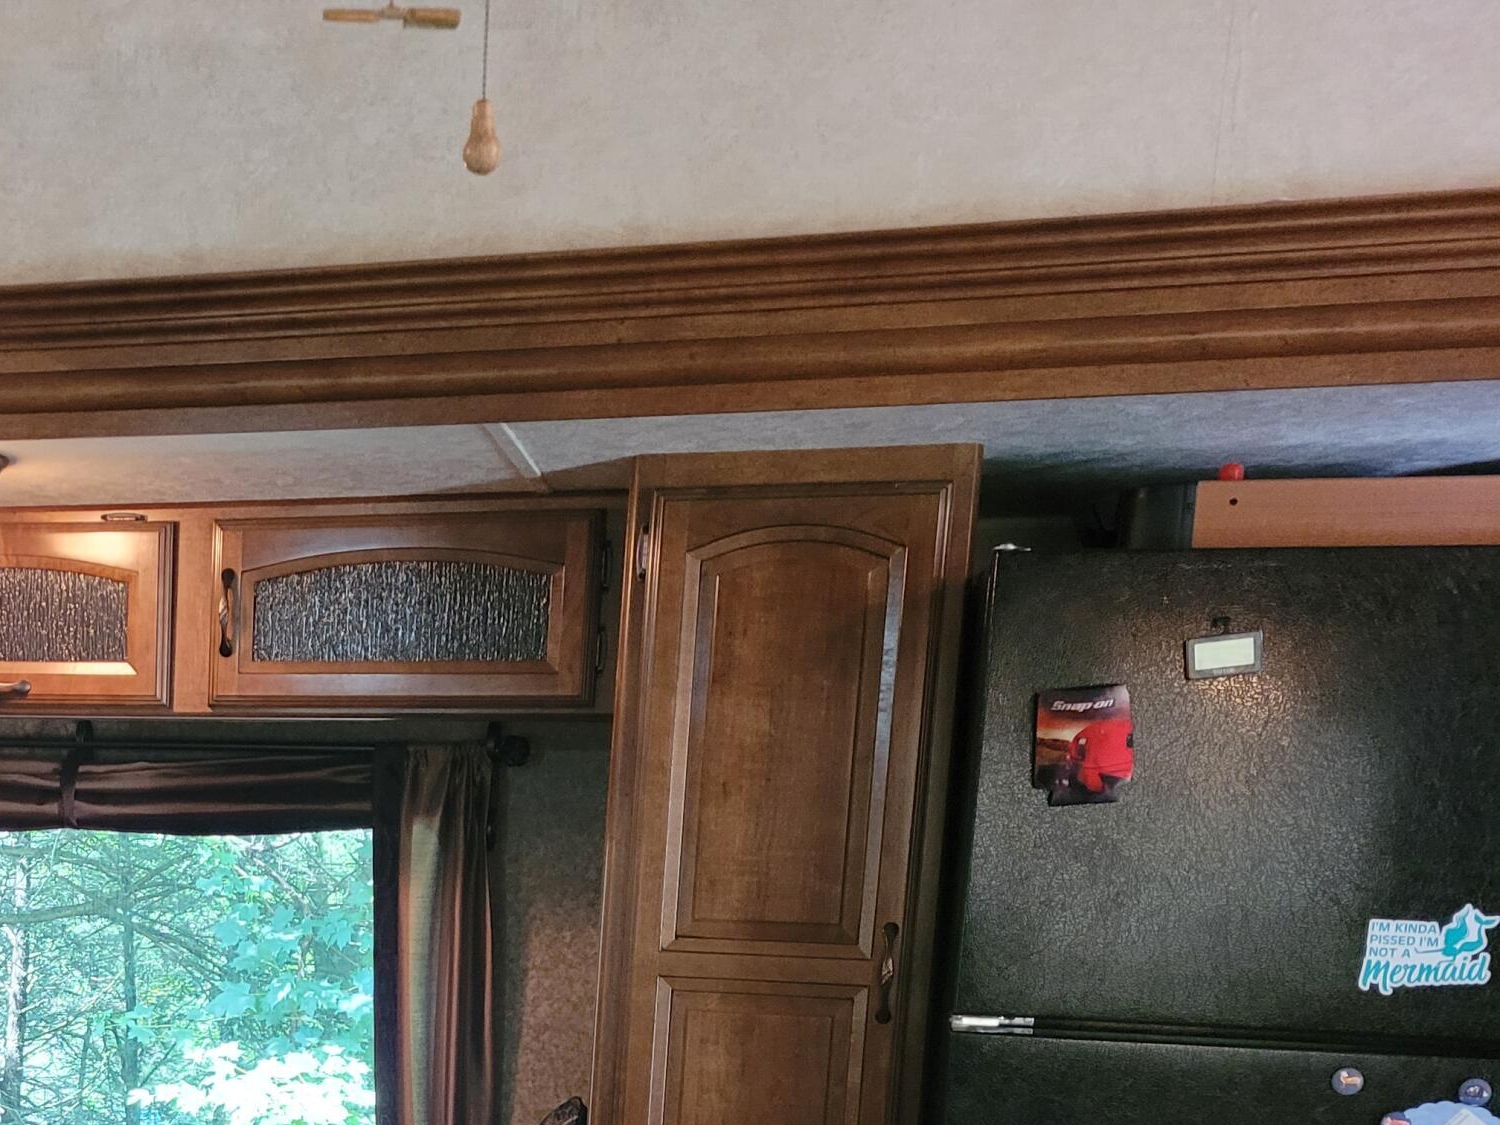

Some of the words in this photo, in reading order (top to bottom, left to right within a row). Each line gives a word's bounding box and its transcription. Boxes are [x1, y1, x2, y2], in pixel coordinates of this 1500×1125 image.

[1371, 921, 1390, 933] I'M
[1395, 922, 1437, 935] KINDA
[1370, 934, 1416, 946] PISSED
[1419, 936, 1439, 948] I'M
[1368, 947, 1397, 958] NOT
[1401, 949, 1411, 958] A
[1363, 955, 1486, 992] Mermaid
